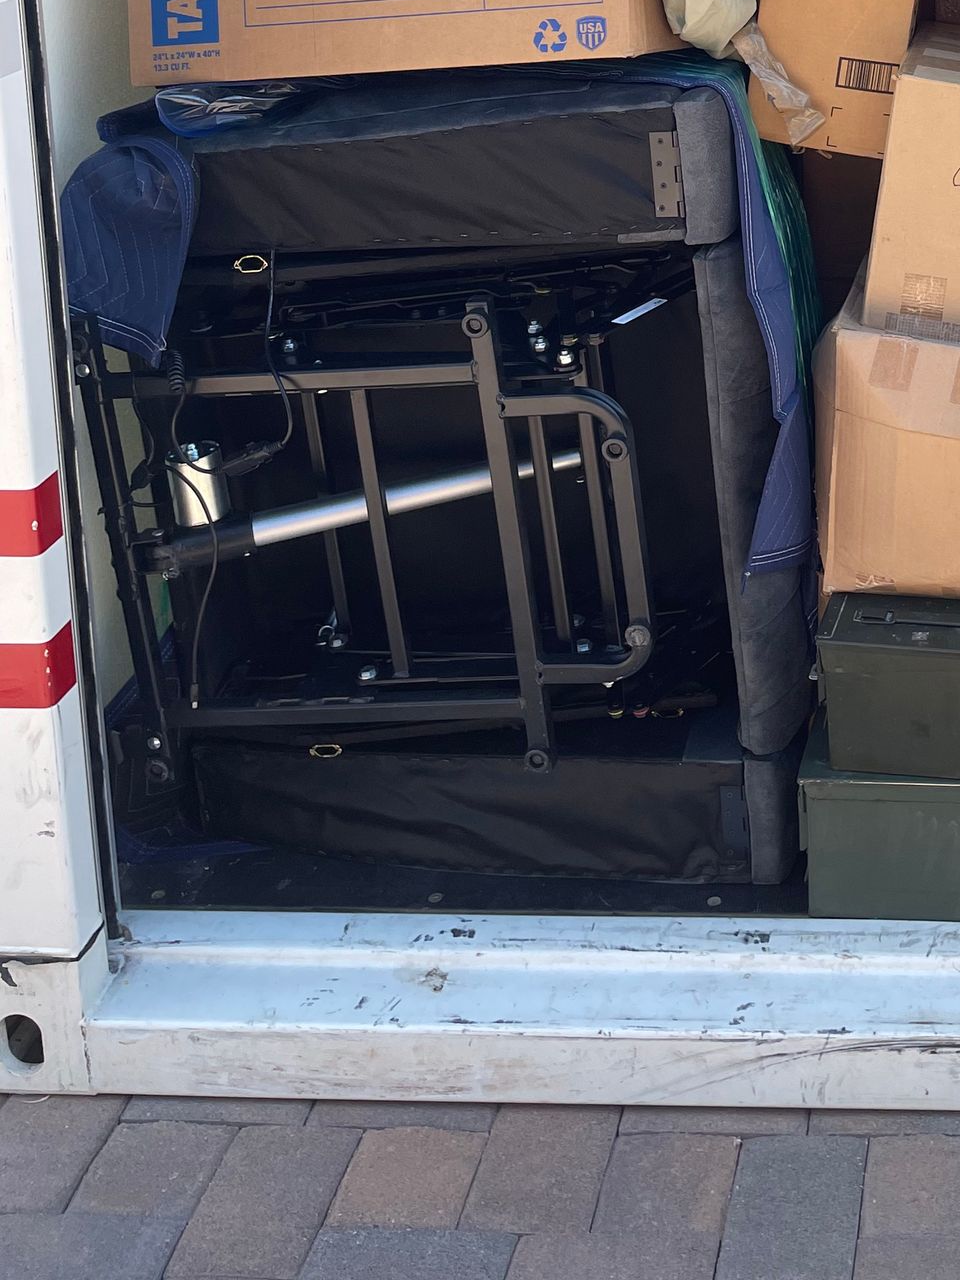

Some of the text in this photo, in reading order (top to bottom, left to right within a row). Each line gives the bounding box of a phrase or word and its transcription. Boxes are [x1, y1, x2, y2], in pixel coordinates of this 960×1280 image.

[578, 21, 604, 35] USA
[154, 63, 169, 72] 13.3
[170, 62, 181, 72] CU
